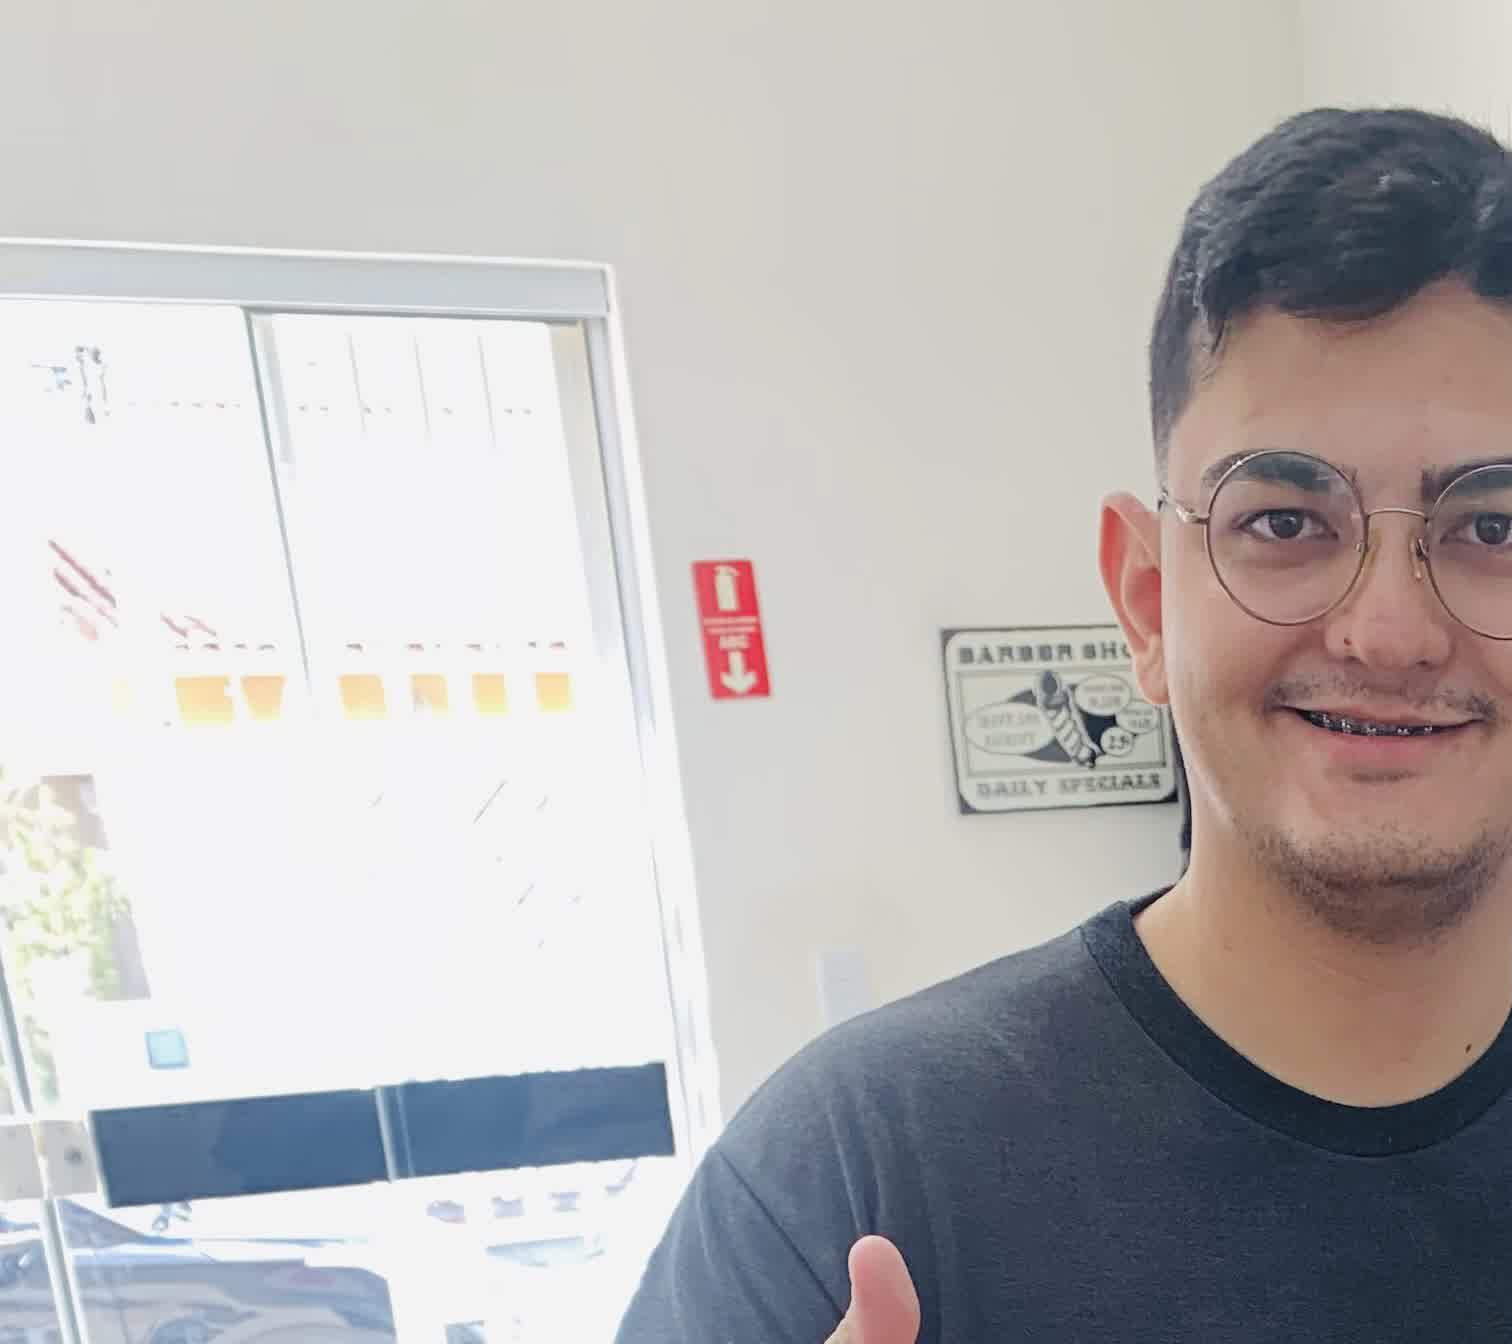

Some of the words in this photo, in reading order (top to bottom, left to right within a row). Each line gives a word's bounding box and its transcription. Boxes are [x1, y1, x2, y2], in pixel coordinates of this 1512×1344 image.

[958, 643, 1073, 664] BARBER
[976, 778, 1048, 798] DAILY
[1058, 773, 1162, 796] SPECIALS
